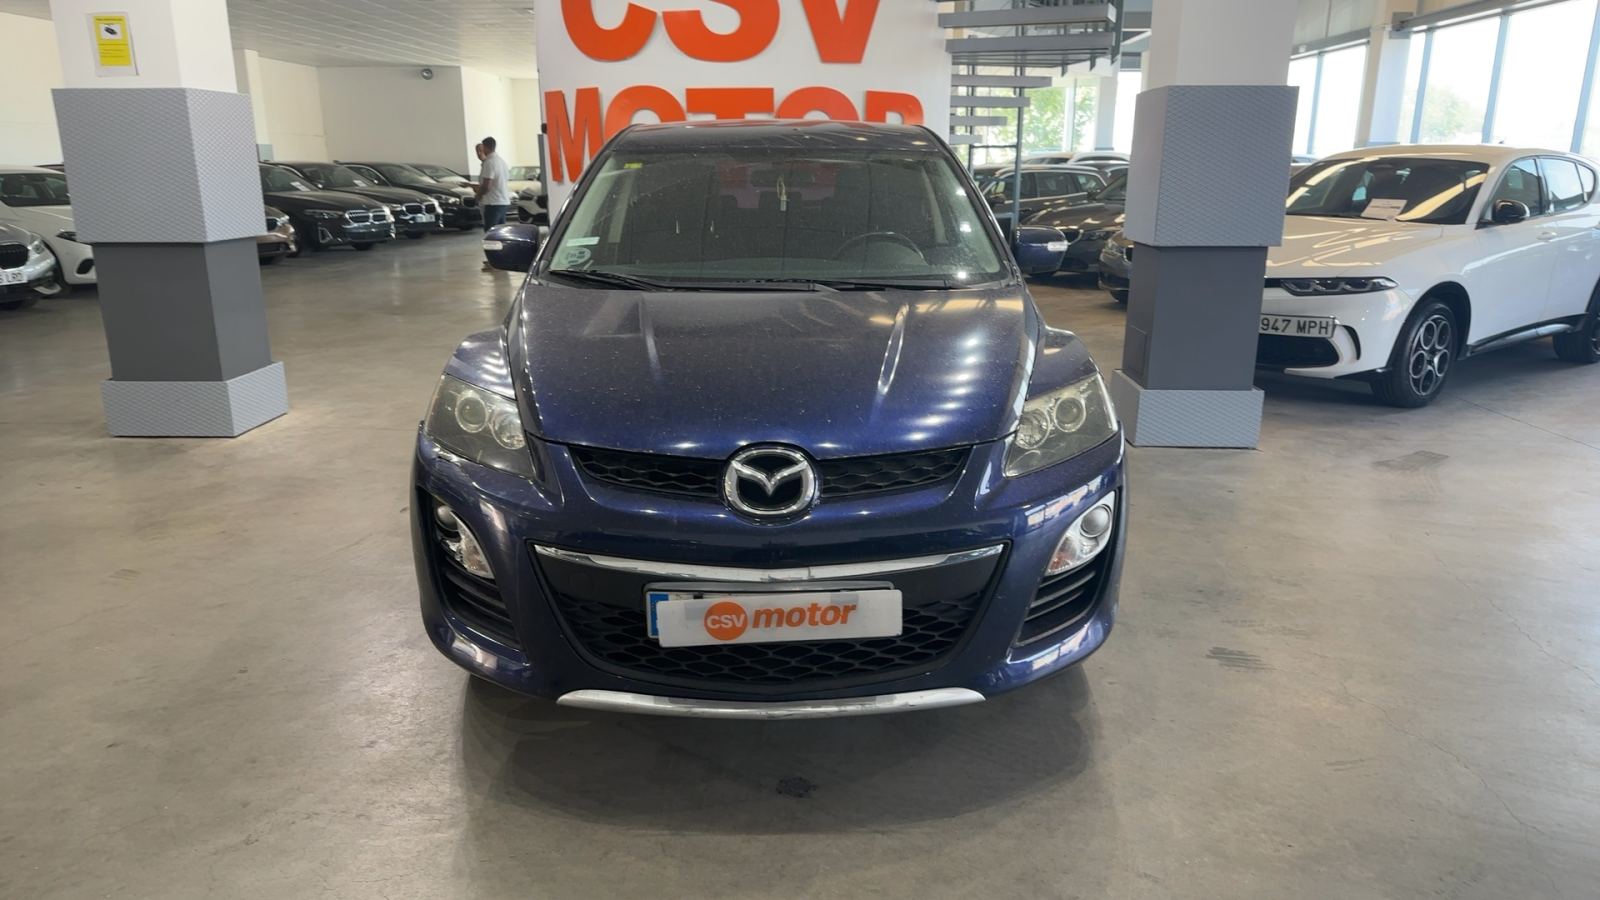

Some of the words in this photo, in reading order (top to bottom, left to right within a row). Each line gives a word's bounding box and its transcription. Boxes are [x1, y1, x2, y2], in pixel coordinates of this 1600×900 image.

[1260, 317, 1292, 333] 947
[1296, 319, 1330, 335] MPH
[752, 602, 857, 629] motor
